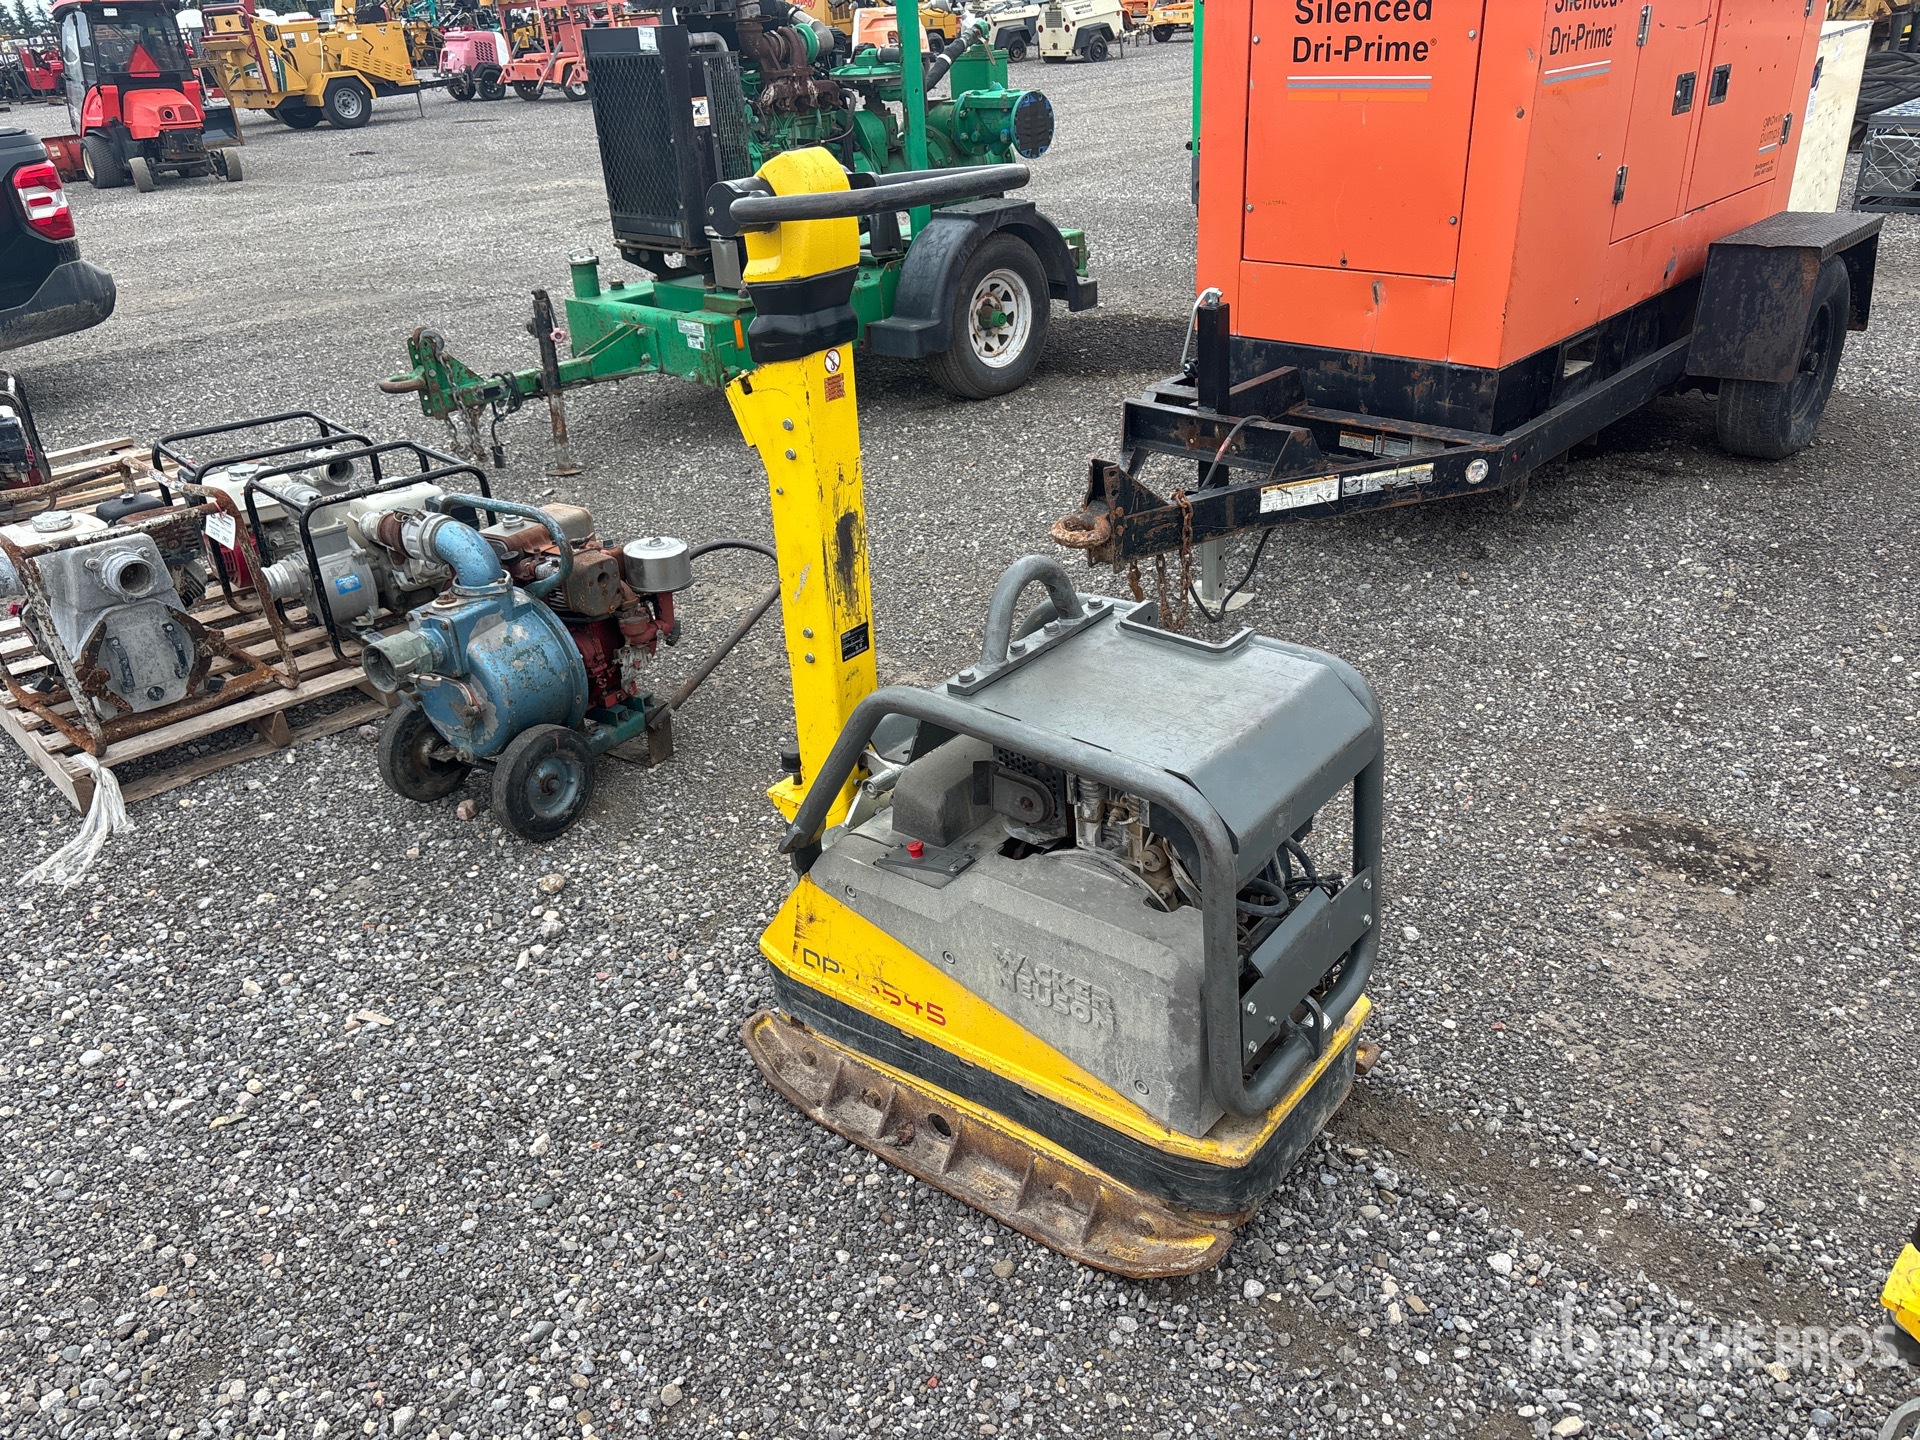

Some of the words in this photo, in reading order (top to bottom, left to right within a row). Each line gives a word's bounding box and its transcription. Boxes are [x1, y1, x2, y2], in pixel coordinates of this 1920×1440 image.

[1294, 0, 1433, 25] Silenced
[991, 941, 1113, 1013] WACKER
[995, 963, 1117, 1035] NEUSON
